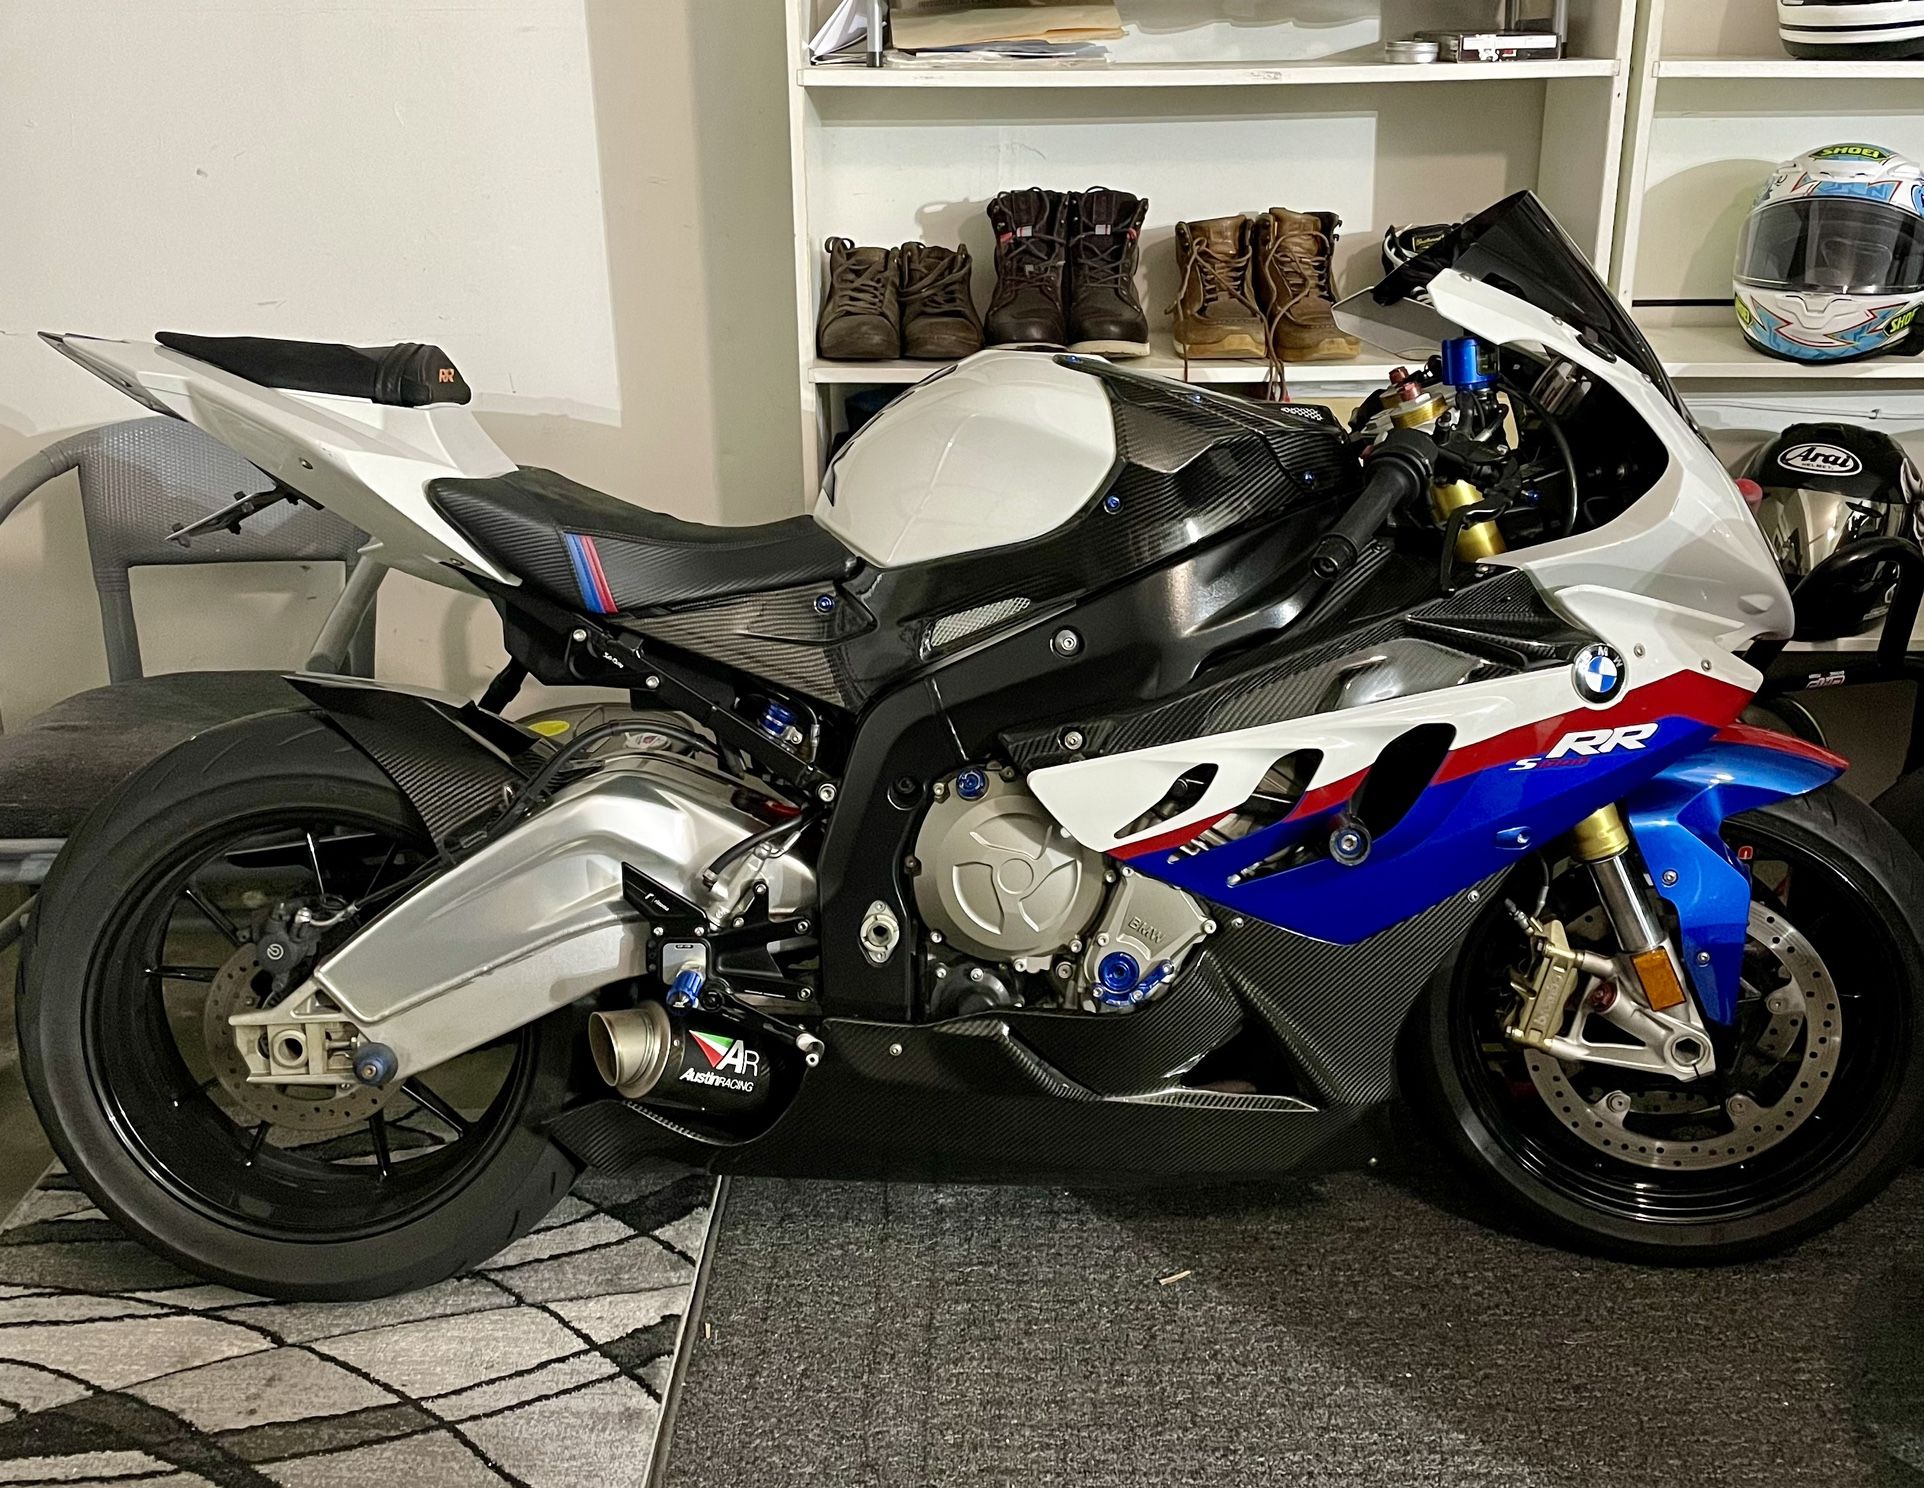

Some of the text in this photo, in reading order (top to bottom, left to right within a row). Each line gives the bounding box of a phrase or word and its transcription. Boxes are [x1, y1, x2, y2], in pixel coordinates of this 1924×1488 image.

[1822, 146, 1880, 158] SHOEI
[1783, 446, 1853, 468] Arai
[1545, 722, 1659, 759] RR
[1128, 916, 1166, 944] BMW
[715, 1039, 760, 1077] AR
